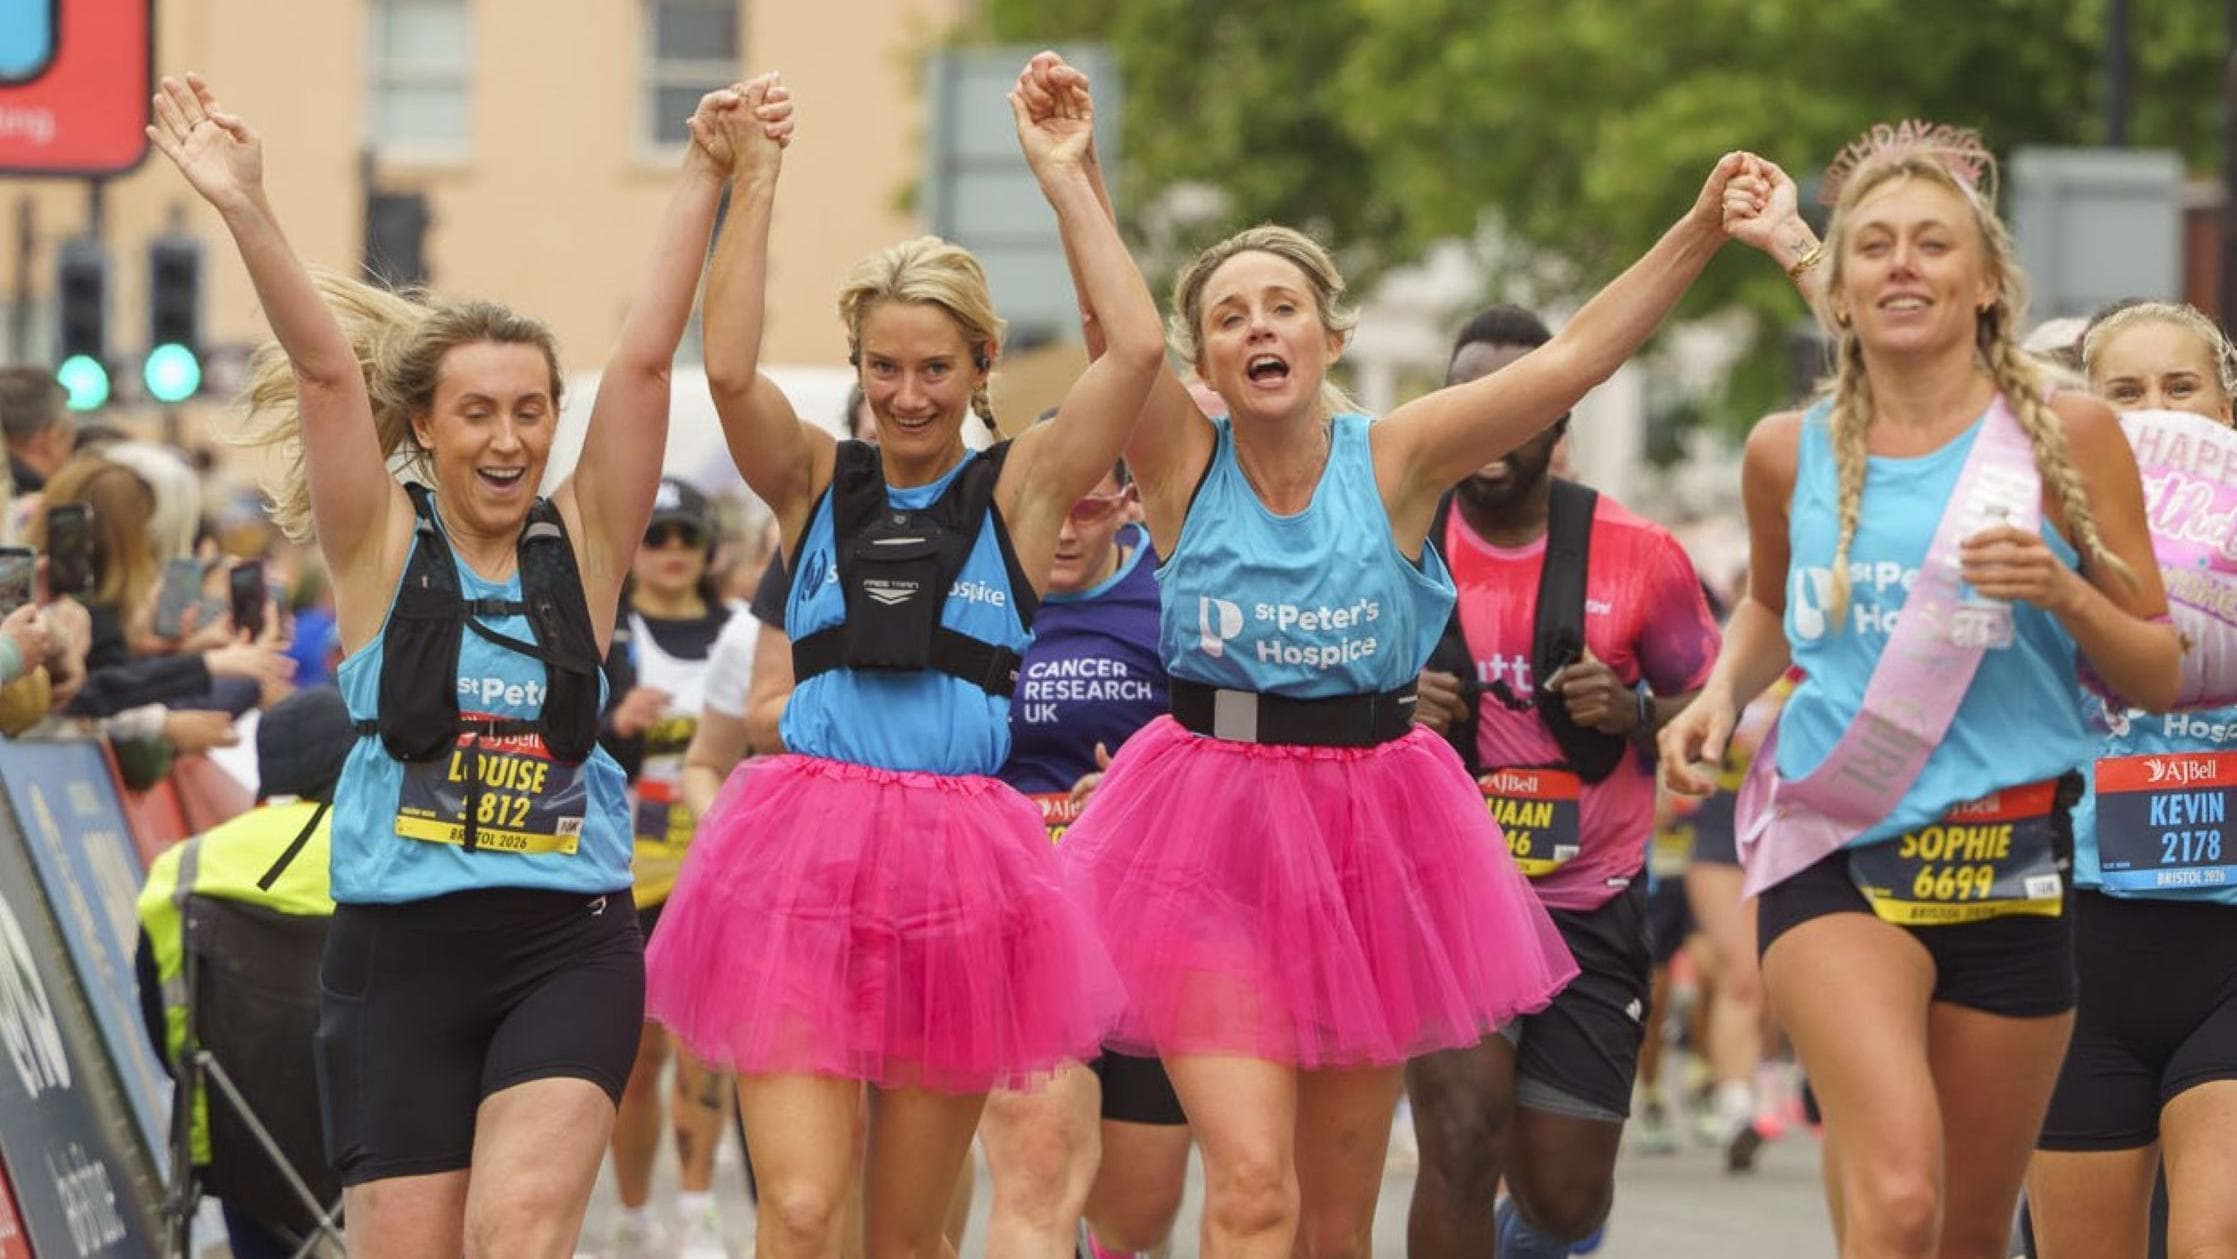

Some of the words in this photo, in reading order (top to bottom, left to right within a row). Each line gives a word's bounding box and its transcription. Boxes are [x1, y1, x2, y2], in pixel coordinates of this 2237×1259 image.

[949, 580, 1006, 607] ospice
[1028, 658, 1128, 679] CANCER
[1256, 636, 1377, 669] Hospice
[1024, 679, 1153, 701] RESEARCH
[1024, 703, 1059, 723] UK
[458, 791, 531, 828] 812
[2151, 792, 2225, 827] KEVIN
[1900, 823, 2013, 861] SOPHIE
[2161, 829, 2221, 864] 2178
[1913, 865, 1995, 900] 6699
